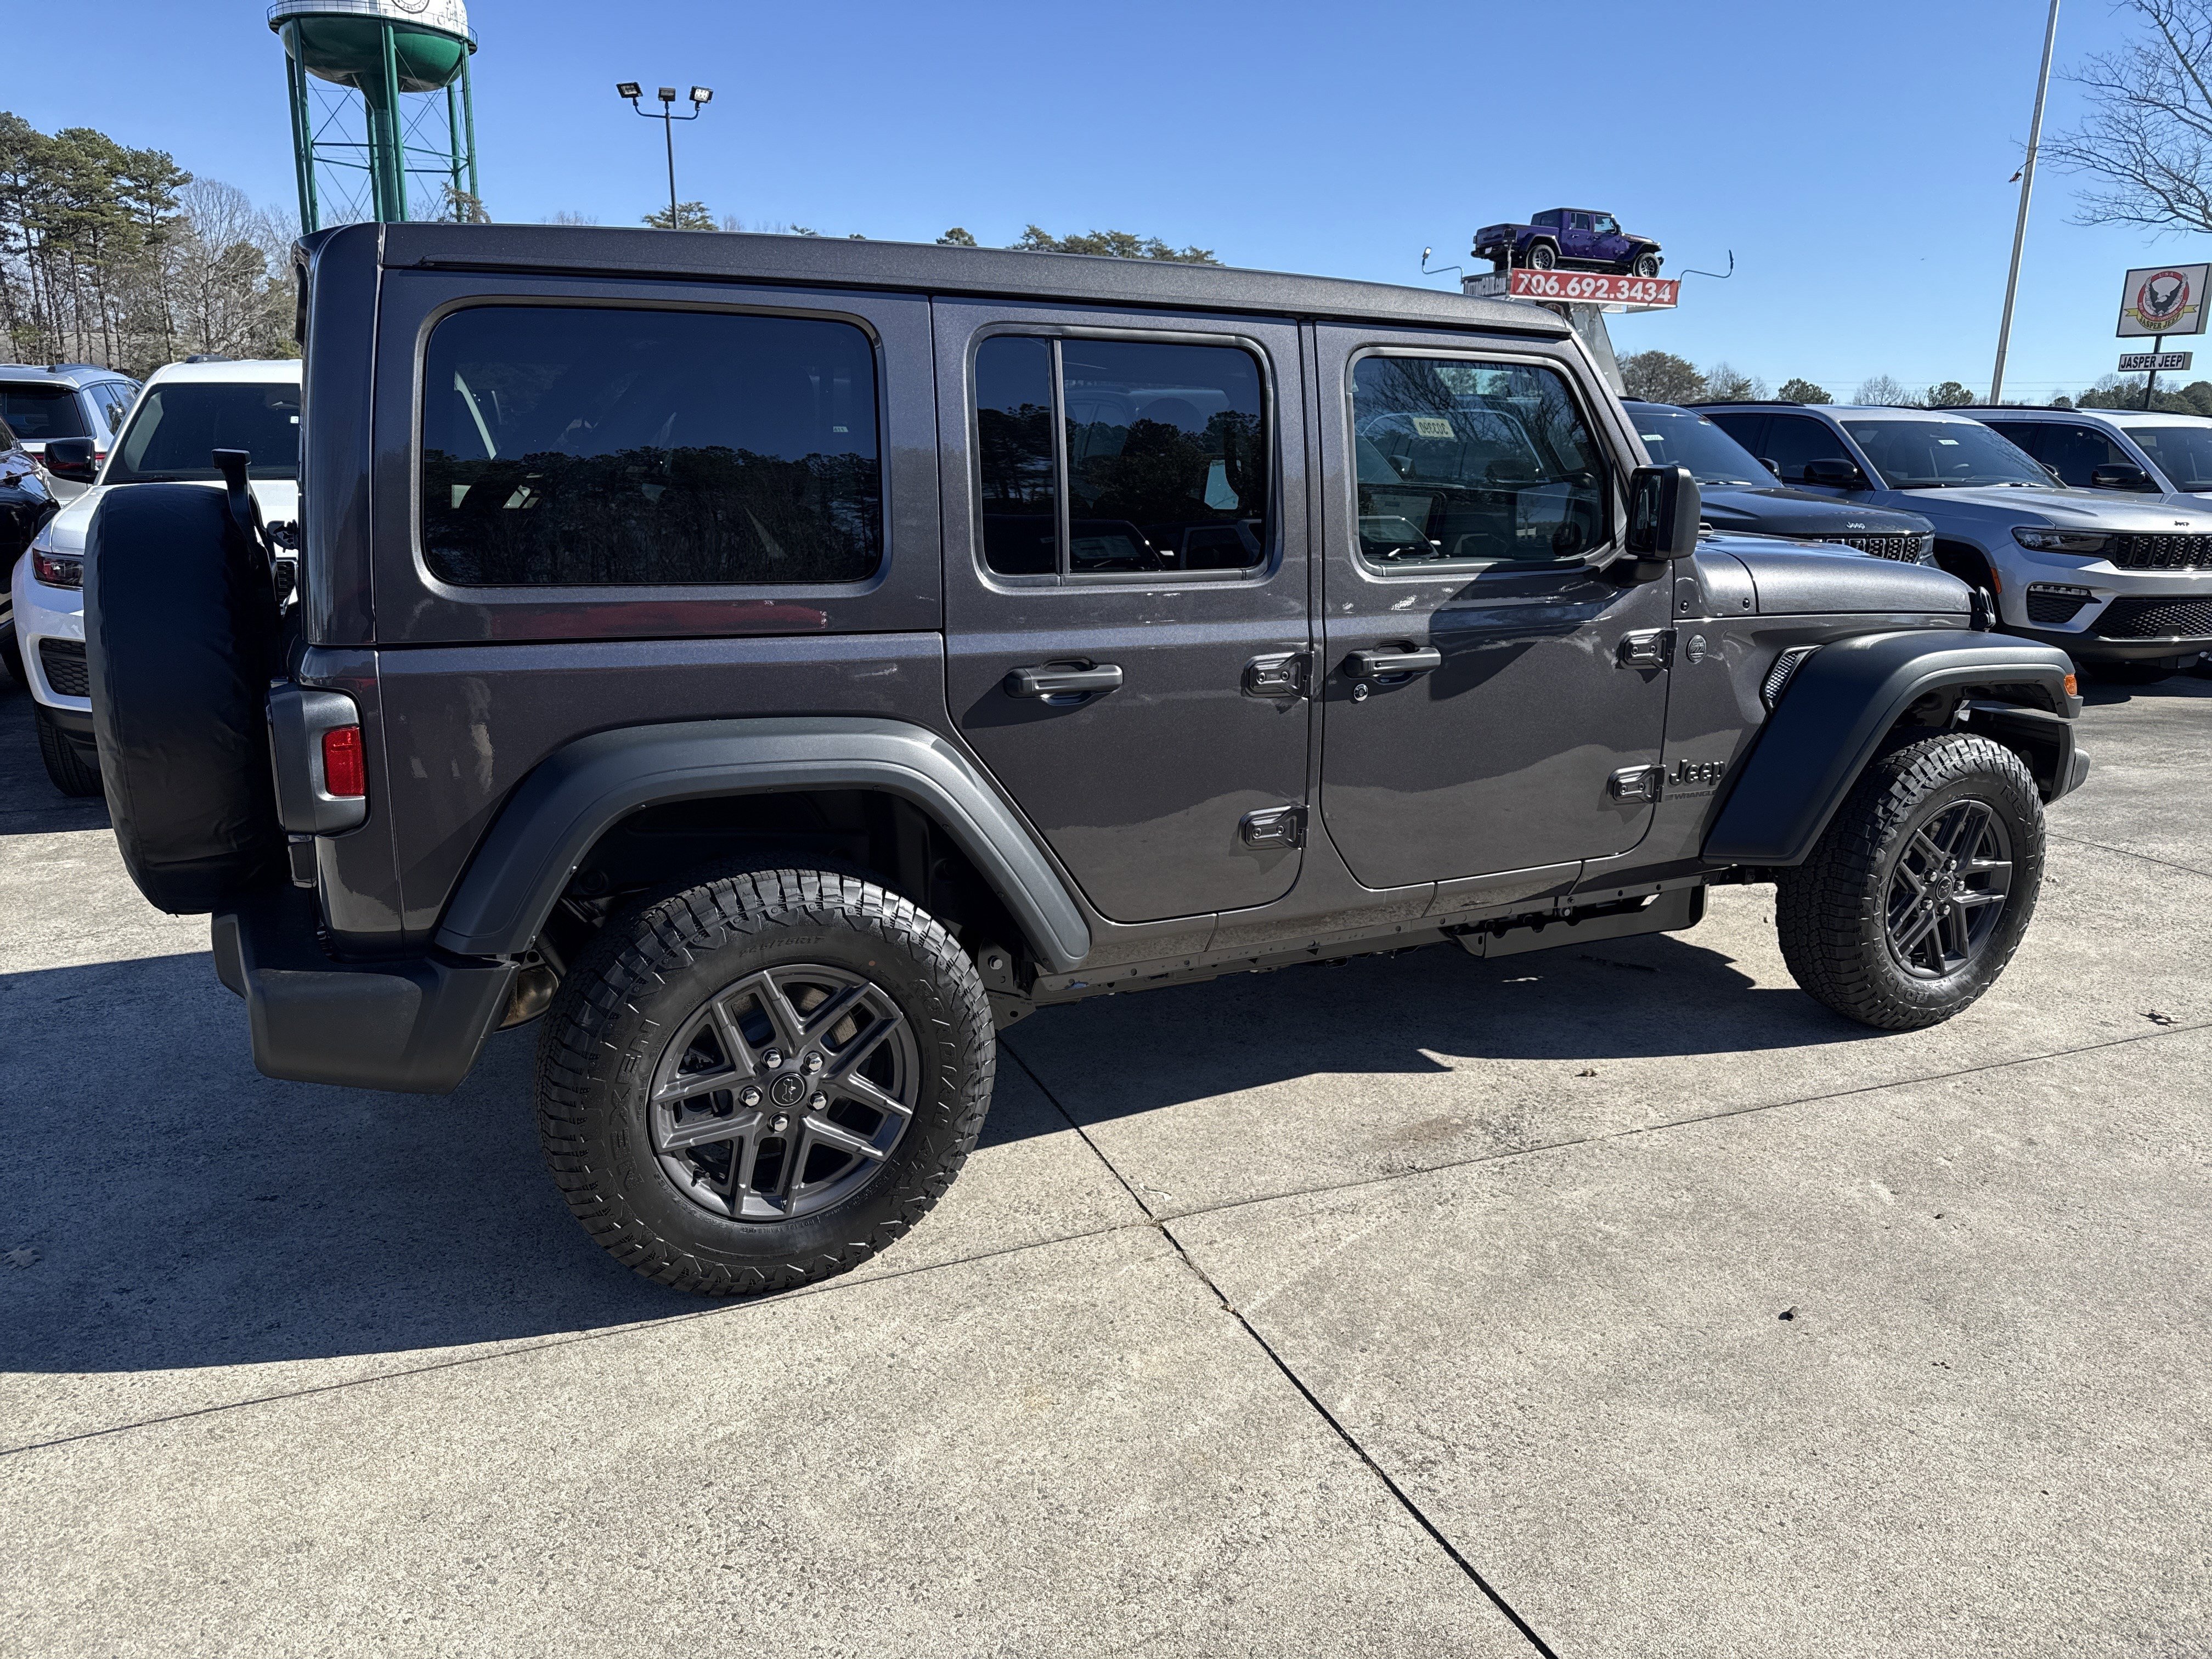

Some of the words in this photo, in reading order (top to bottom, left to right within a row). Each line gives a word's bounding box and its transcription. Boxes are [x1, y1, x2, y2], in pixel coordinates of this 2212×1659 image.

[1516, 273, 1671, 302] 706.692.3434
[2140, 316, 2162, 329] JASPER
[2163, 313, 2180, 328] JEEP
[2121, 356, 2157, 369] JASPER
[2158, 354, 2183, 368] JEEP
[1846, 521, 1865, 529] Jeep
[1668, 759, 1726, 786] Jeep
[2000, 785, 2035, 877] NEXEN
[907, 979, 957, 1130] ROADIAN
[609, 1019, 661, 1192] NEXEN
